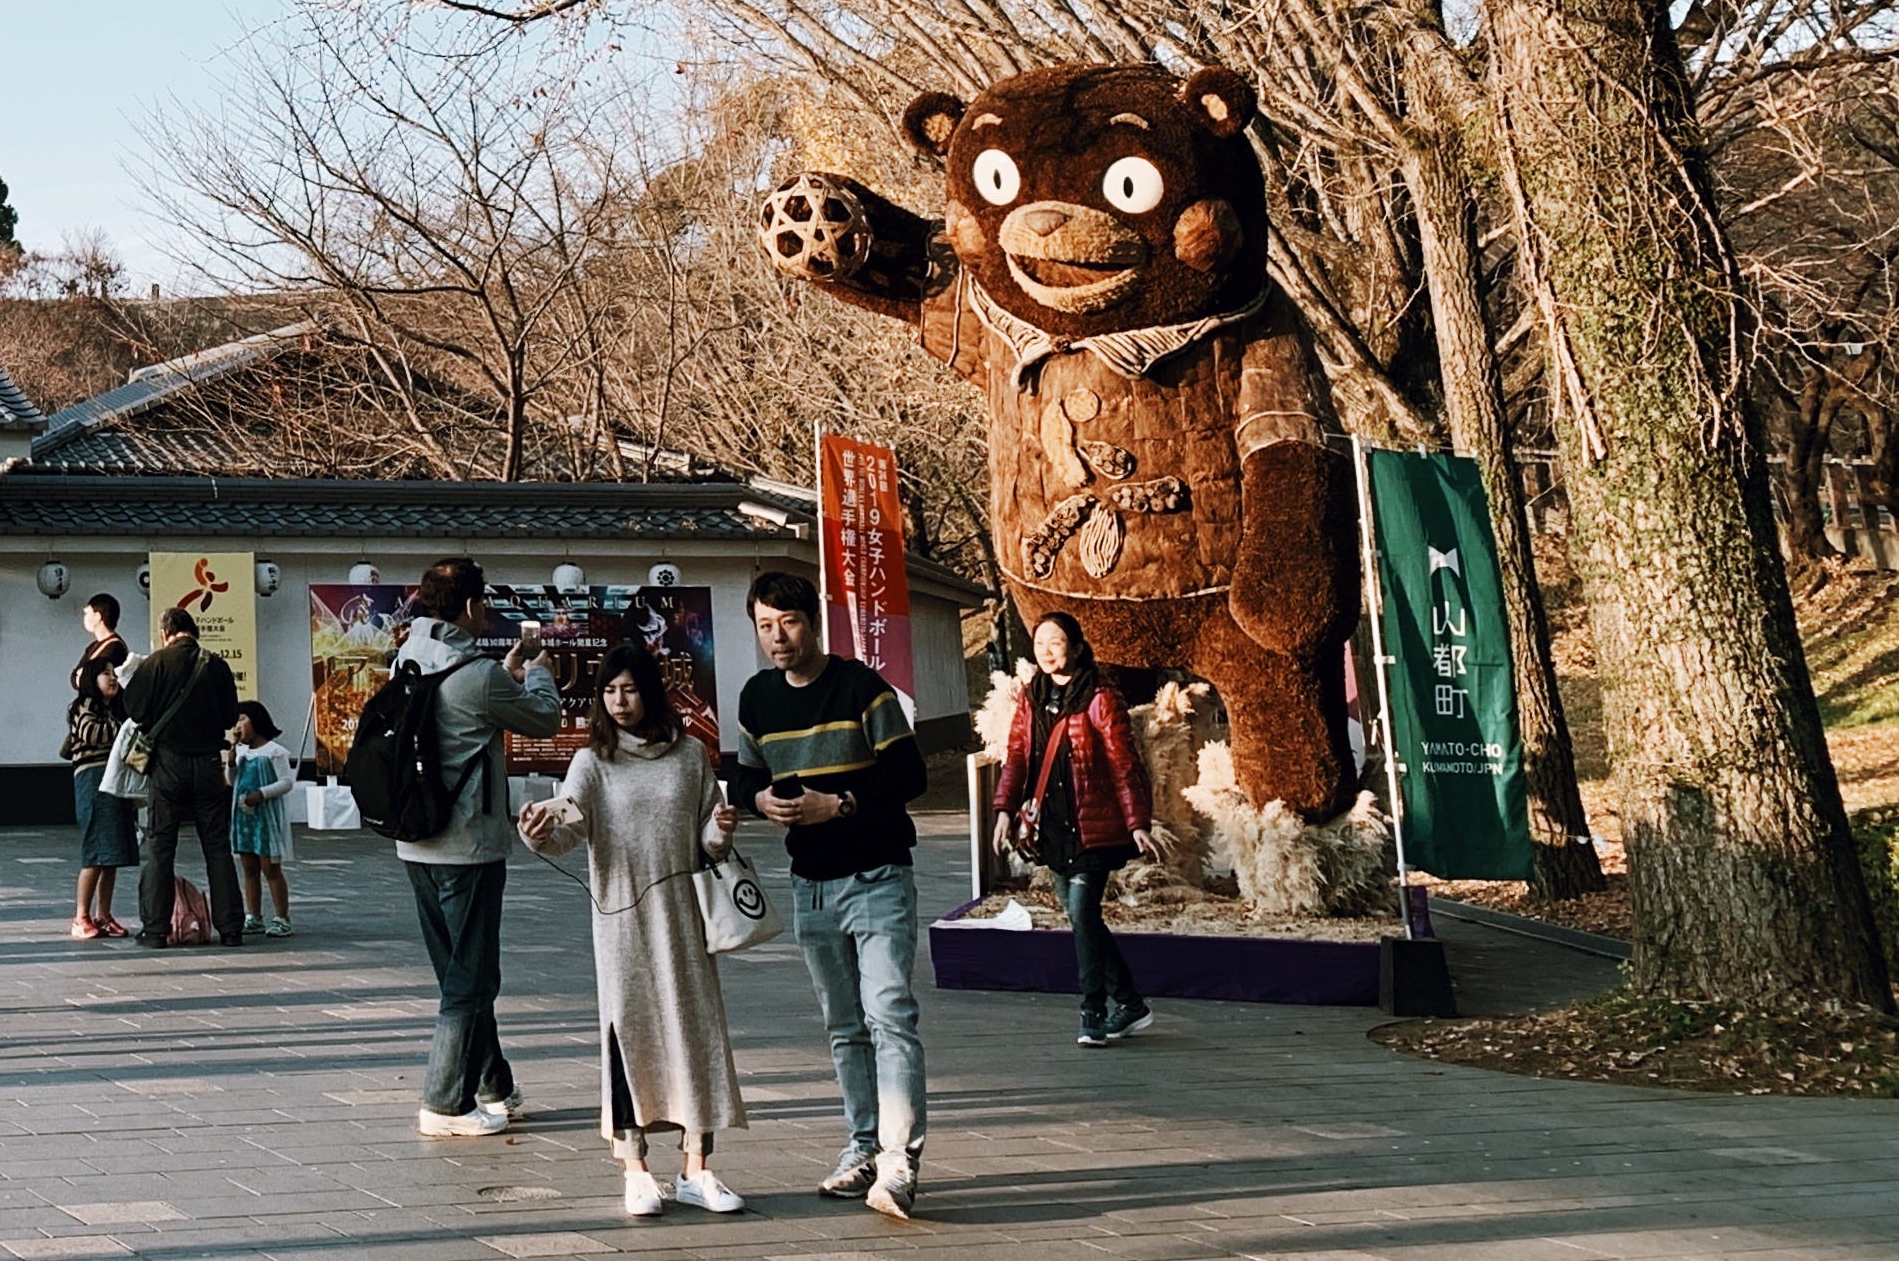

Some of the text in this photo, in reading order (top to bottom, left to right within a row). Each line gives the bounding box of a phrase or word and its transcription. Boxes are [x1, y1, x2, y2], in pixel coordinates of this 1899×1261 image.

[841, 450, 857, 586] 世界選手権大会
[866, 455, 887, 671] 2019女子ハンドボール
[1433, 600, 1469, 719] 山都町
[1421, 741, 1503, 758] YAMATO-CHO
[1422, 761, 1503, 775] KUMAMOTO/JPN
